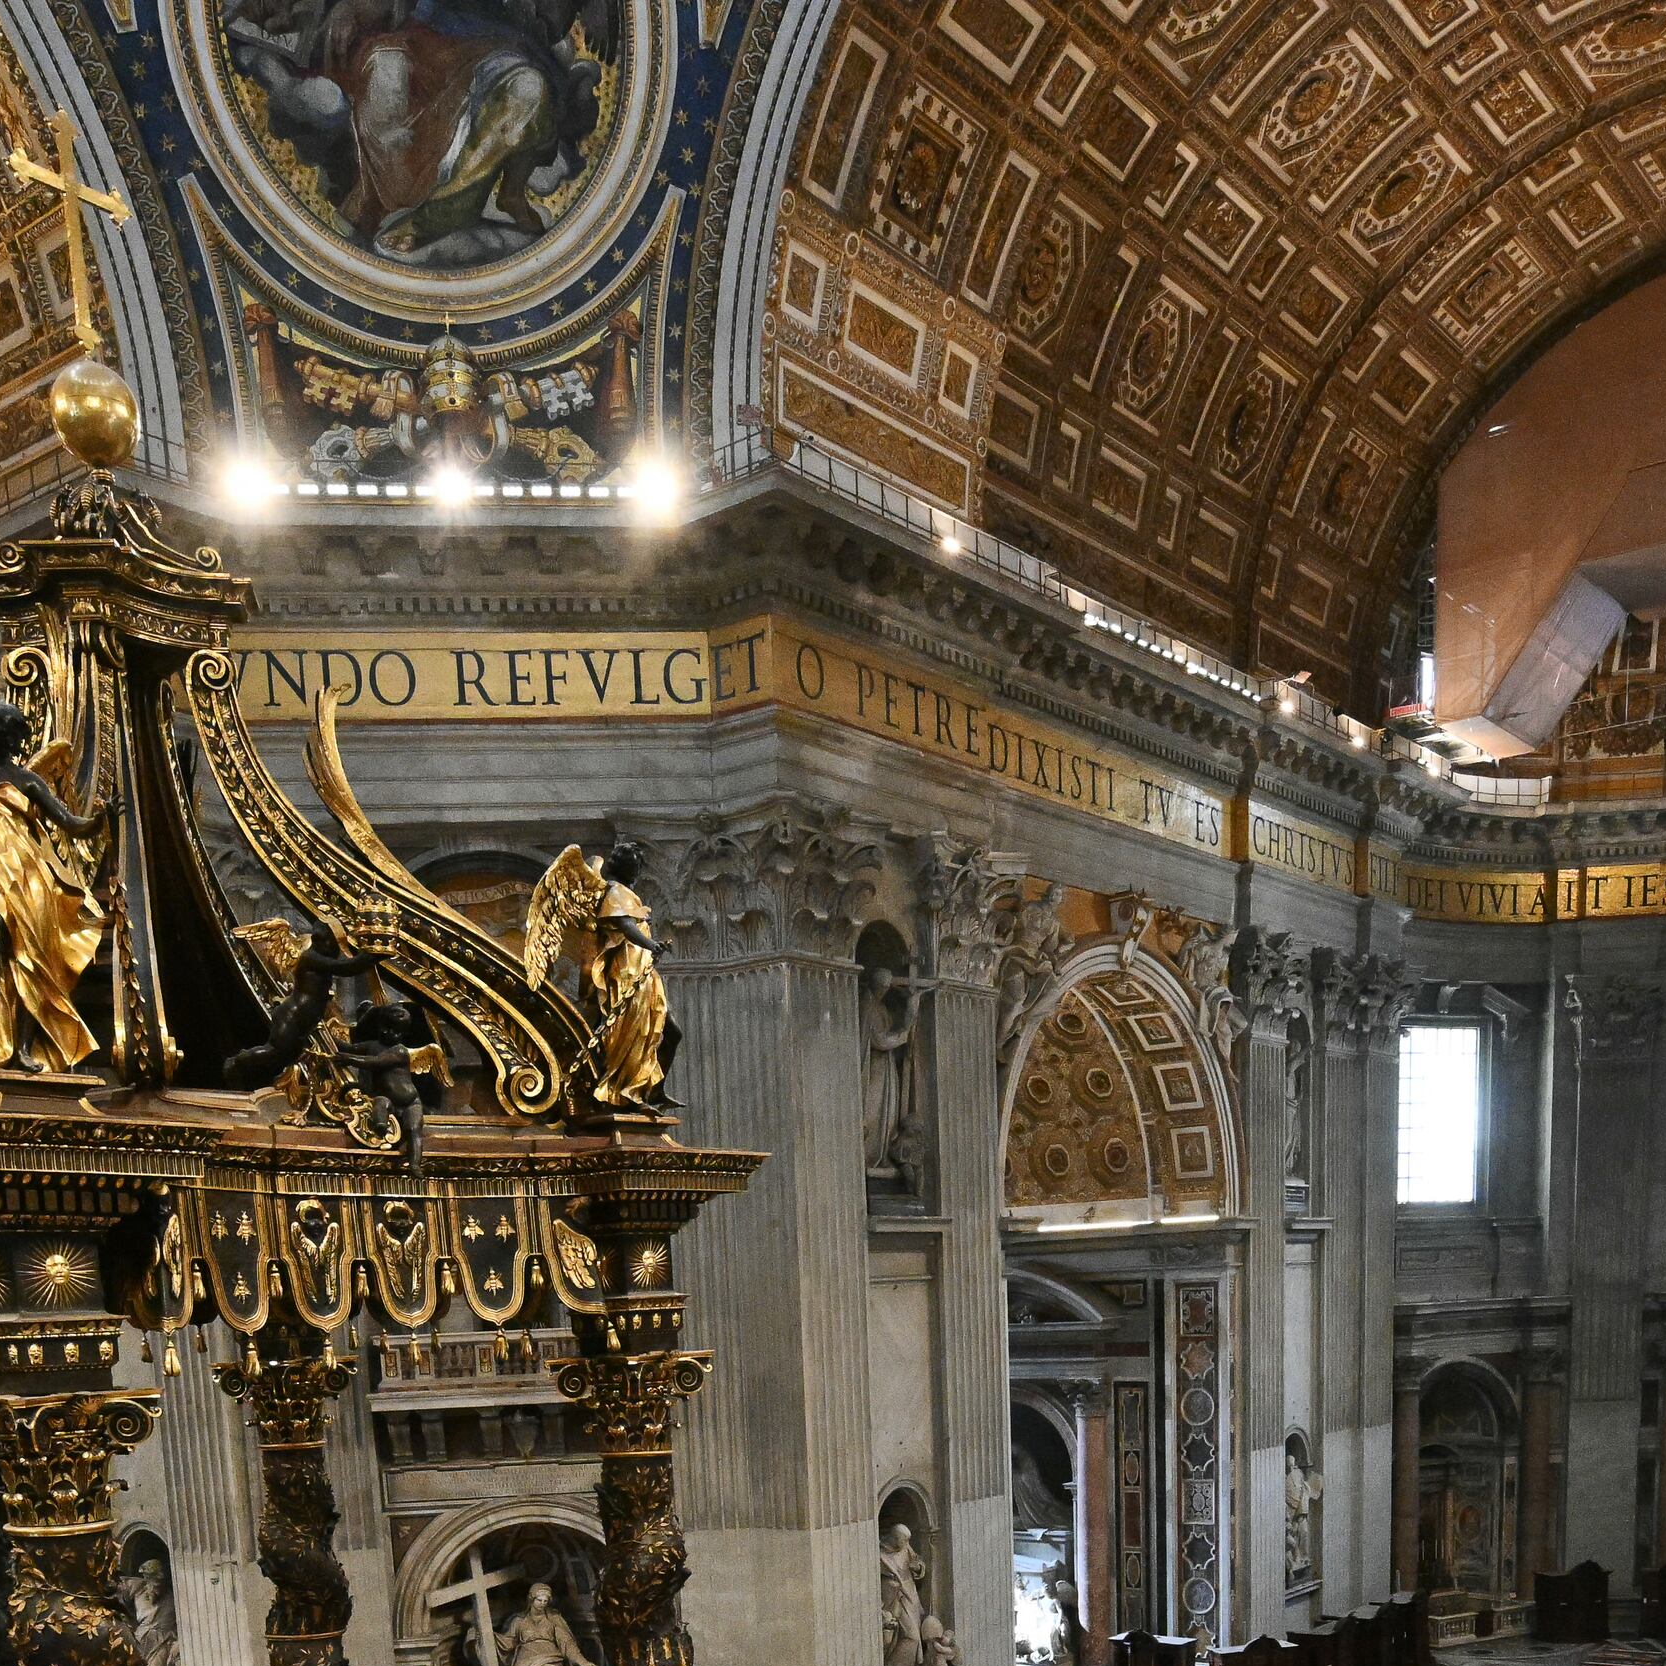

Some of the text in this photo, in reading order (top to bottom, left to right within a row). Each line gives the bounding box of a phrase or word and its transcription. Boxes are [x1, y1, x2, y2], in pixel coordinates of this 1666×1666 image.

[450, 631, 767, 708] REFVLGET
[796, 644, 824, 700] O
[855, 662, 982, 757] PETRE
[988, 722, 1116, 812] DIXISTI
[1139, 776, 1174, 827] TV
[1194, 800, 1221, 846] ES
[1253, 816, 1354, 887] CHRISTVS
[1456, 882, 1518, 916] VIVI
